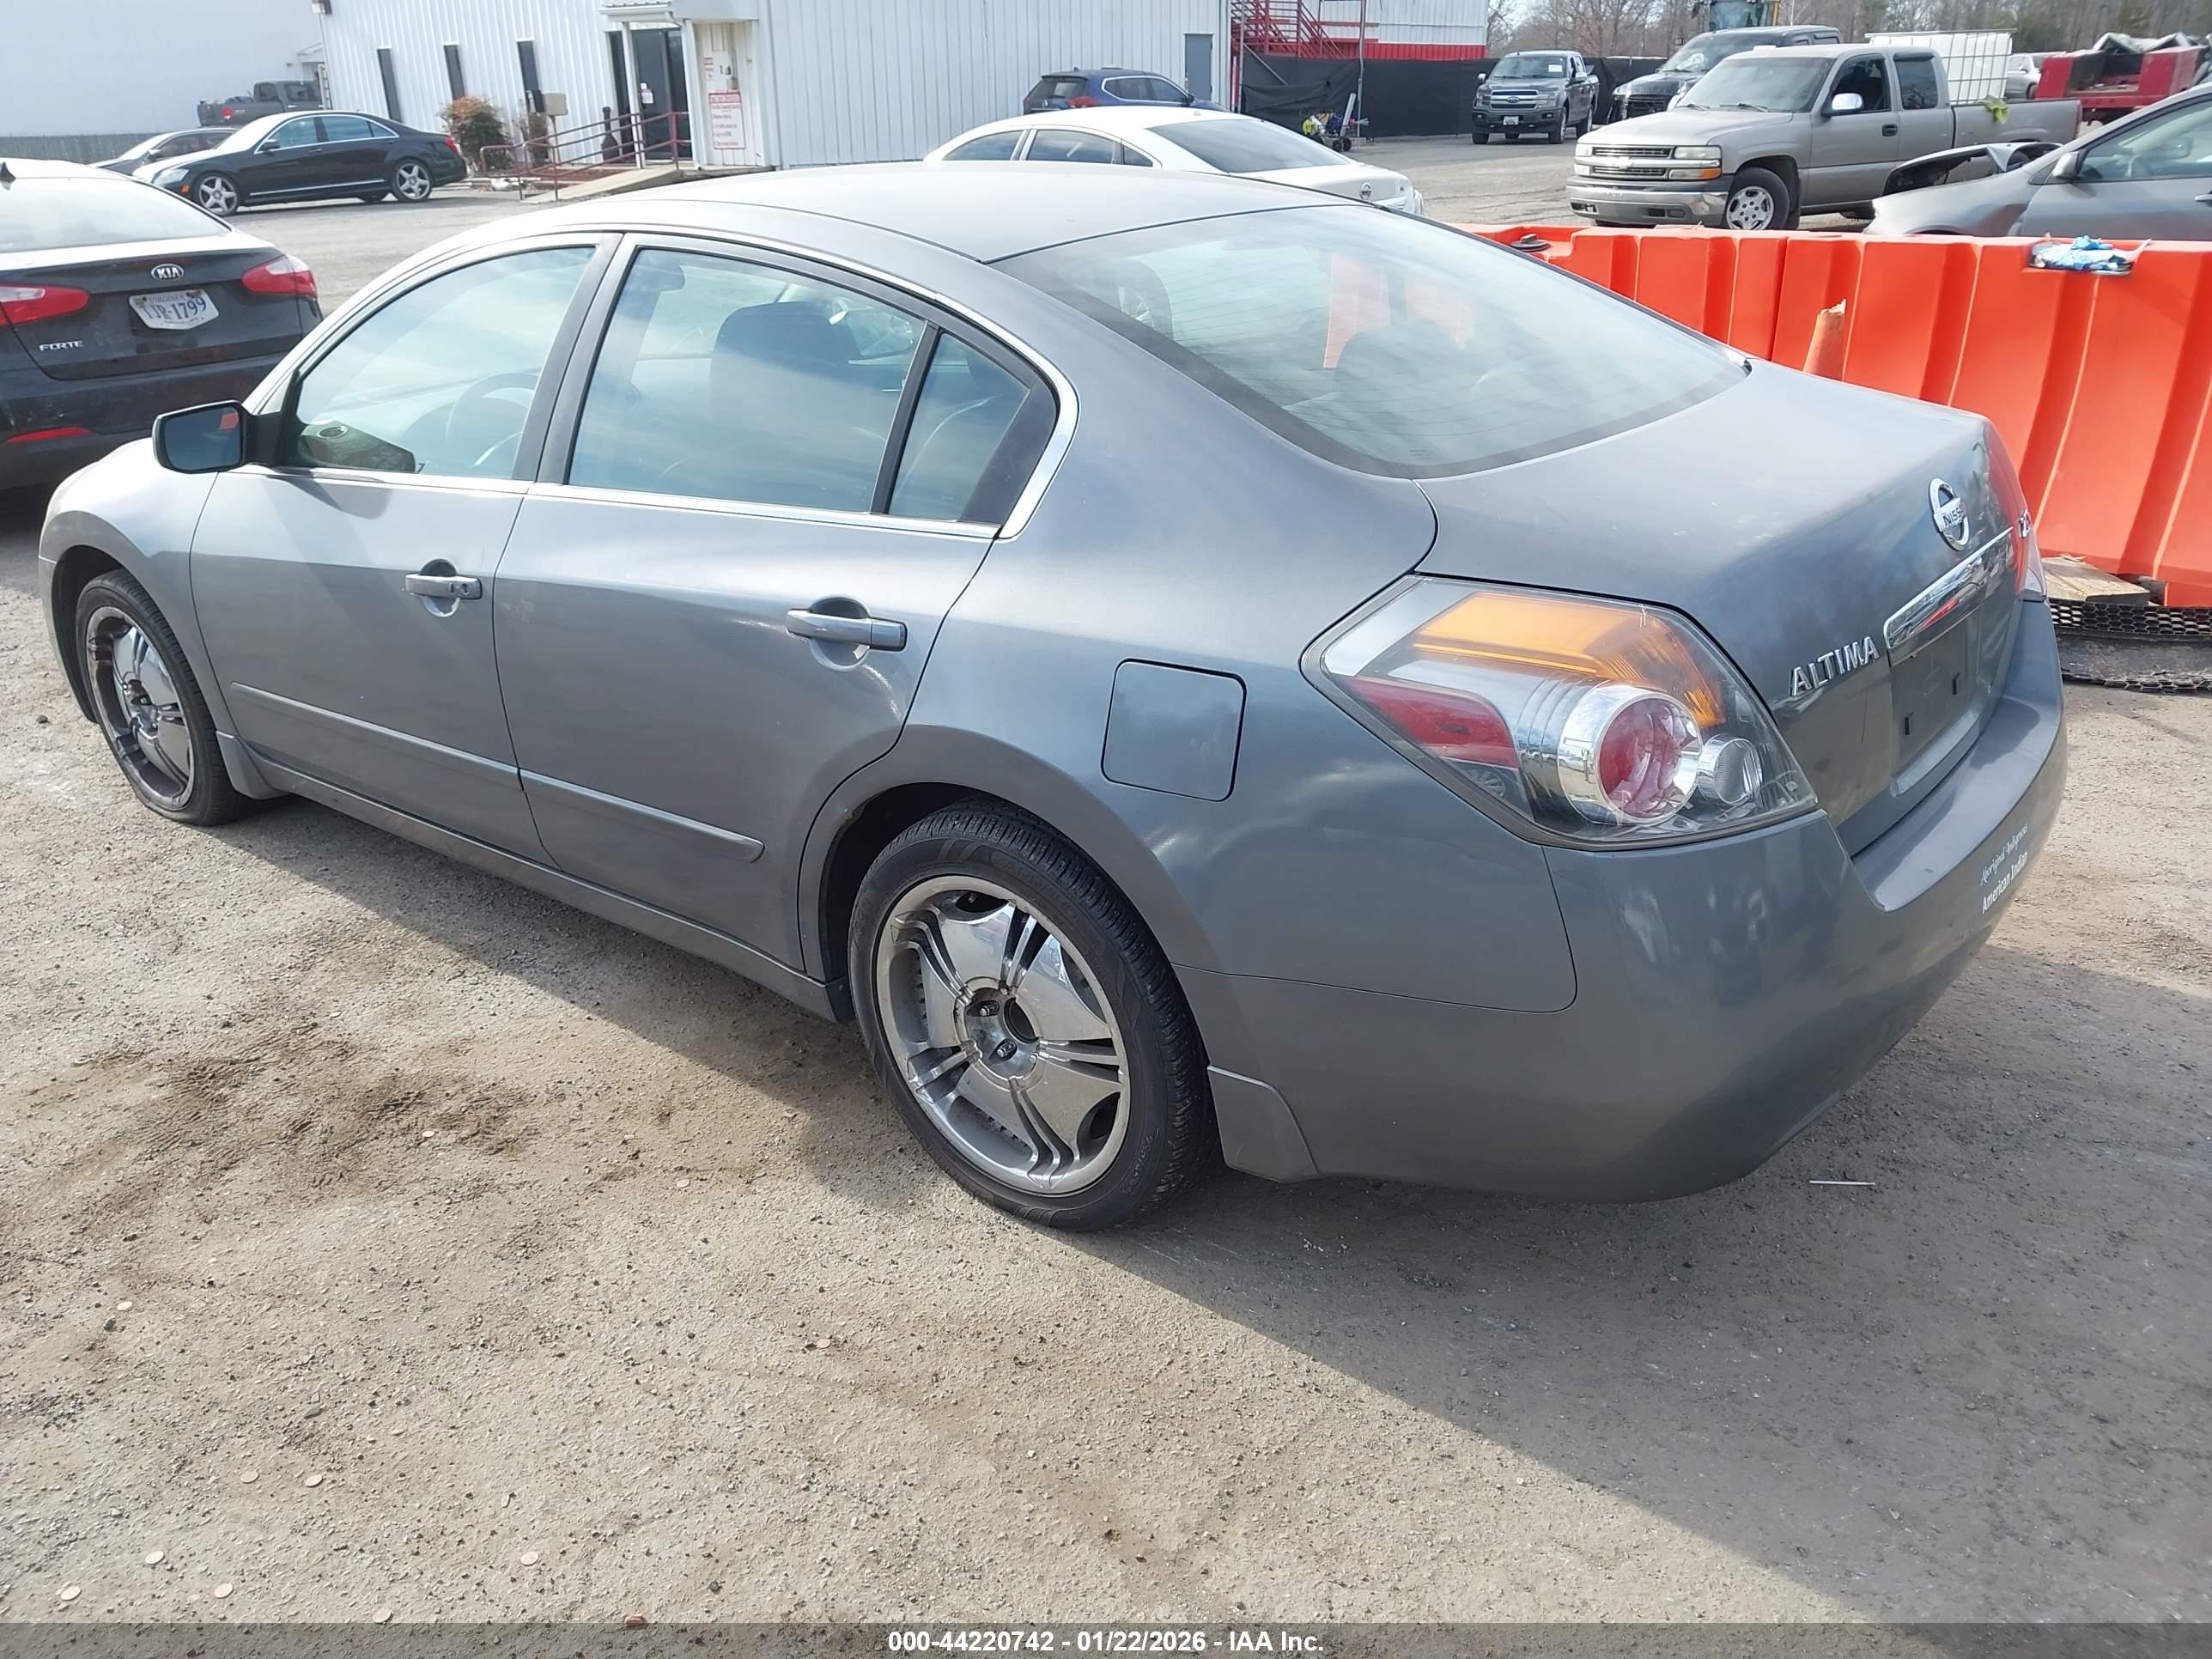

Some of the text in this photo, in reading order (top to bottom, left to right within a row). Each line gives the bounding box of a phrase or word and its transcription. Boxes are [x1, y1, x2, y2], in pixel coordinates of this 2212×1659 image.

[156, 266, 180, 279] KIA
[39, 340, 84, 351] FORTE
[1789, 635, 1880, 696] ALTIMA
[1982, 851, 2028, 915] American Indian
